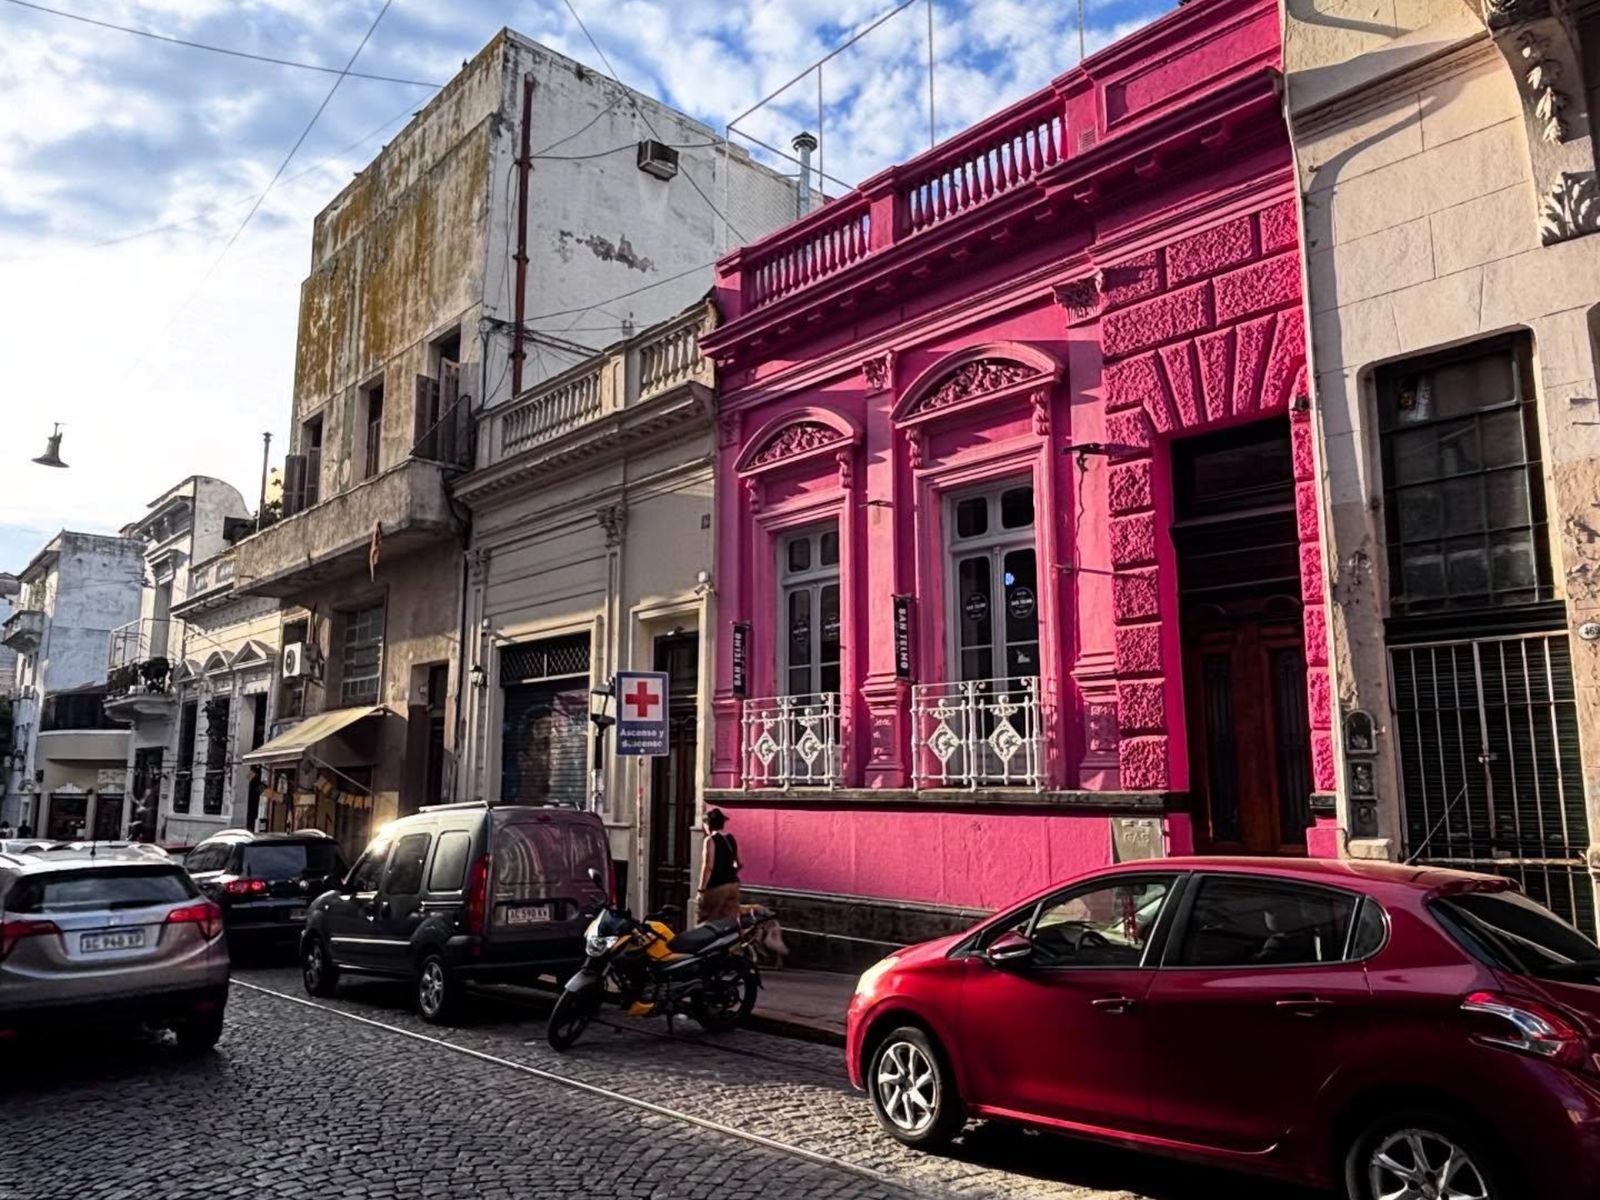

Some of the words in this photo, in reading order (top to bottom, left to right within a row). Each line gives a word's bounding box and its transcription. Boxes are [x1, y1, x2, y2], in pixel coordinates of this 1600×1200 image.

[898, 608, 907, 630] SAN
[734, 632, 742, 662] TELMO
[899, 634, 909, 669] TELMO
[620, 728, 657, 737] Ascenso
